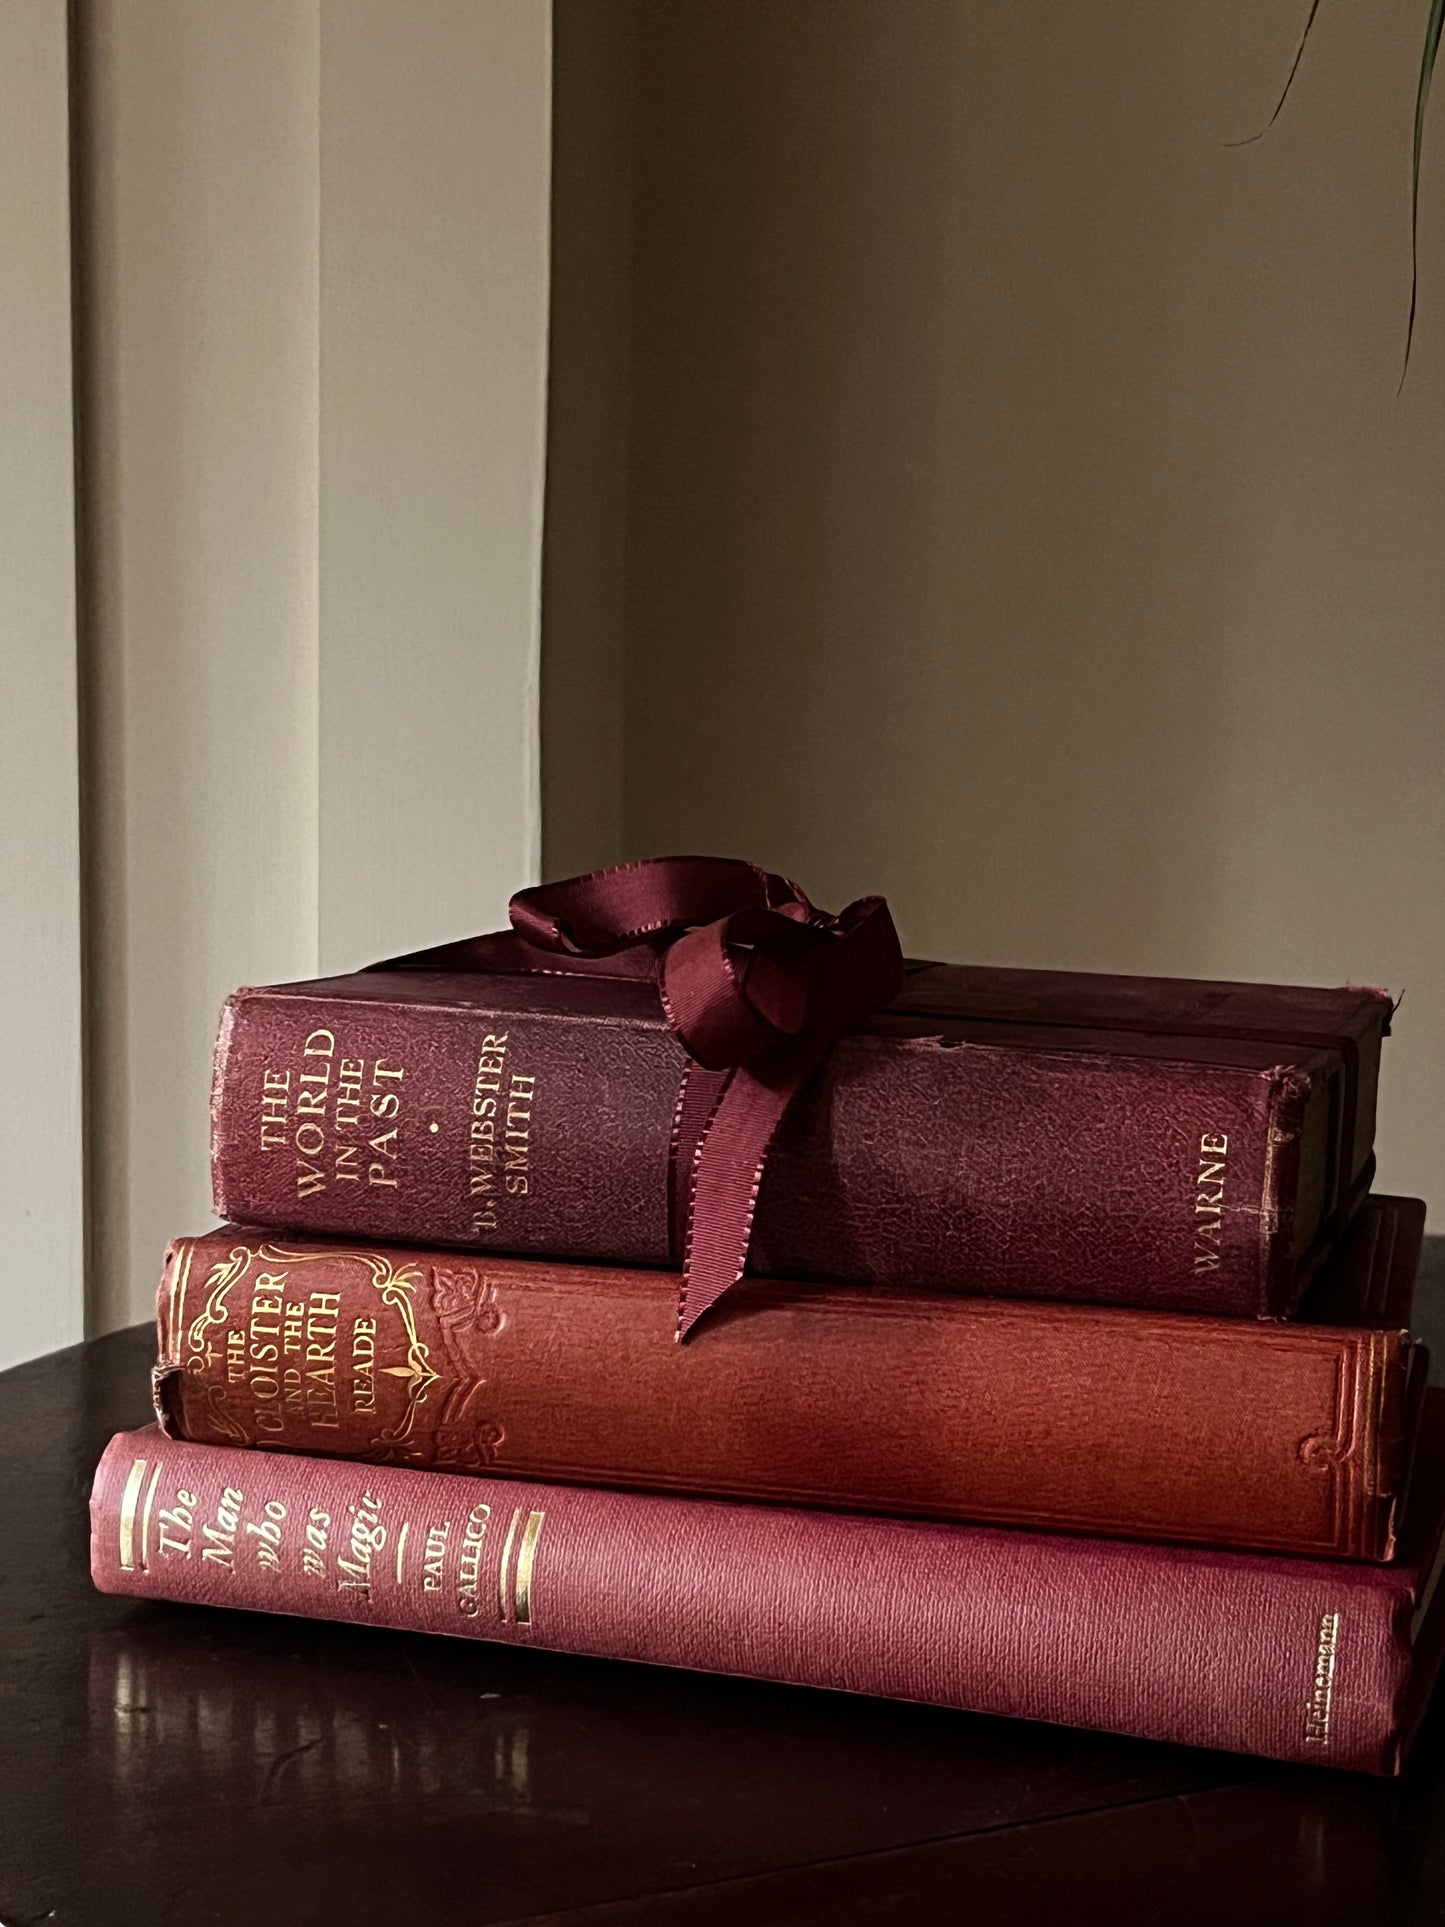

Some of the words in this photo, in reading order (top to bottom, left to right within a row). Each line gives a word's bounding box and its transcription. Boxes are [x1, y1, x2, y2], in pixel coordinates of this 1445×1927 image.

[260, 1068, 291, 1151] THE
[295, 1028, 335, 1198] WORLD
[336, 1058, 364, 1131] THE
[368, 1058, 404, 1188] PAST
[469, 1030, 510, 1196] WEBSTER
[504, 1074, 536, 1195] SMITH
[335, 1144, 361, 1182] IN
[1193, 1133, 1228, 1276] WARNE
[226, 1329, 246, 1383] THE
[250, 1271, 289, 1432] CLOISTER
[284, 1301, 305, 1355] THE
[305, 1292, 341, 1429] HEARTH
[352, 1317, 377, 1415] READE
[284, 1368, 304, 1415] AND
[158, 1489, 197, 1558] The
[201, 1486, 243, 1575] Man
[248, 1501, 286, 1571] who
[303, 1506, 331, 1578] was
[337, 1488, 387, 1604] Magic
[423, 1520, 451, 1593] PAUL
[459, 1503, 491, 1619] GALLICO
